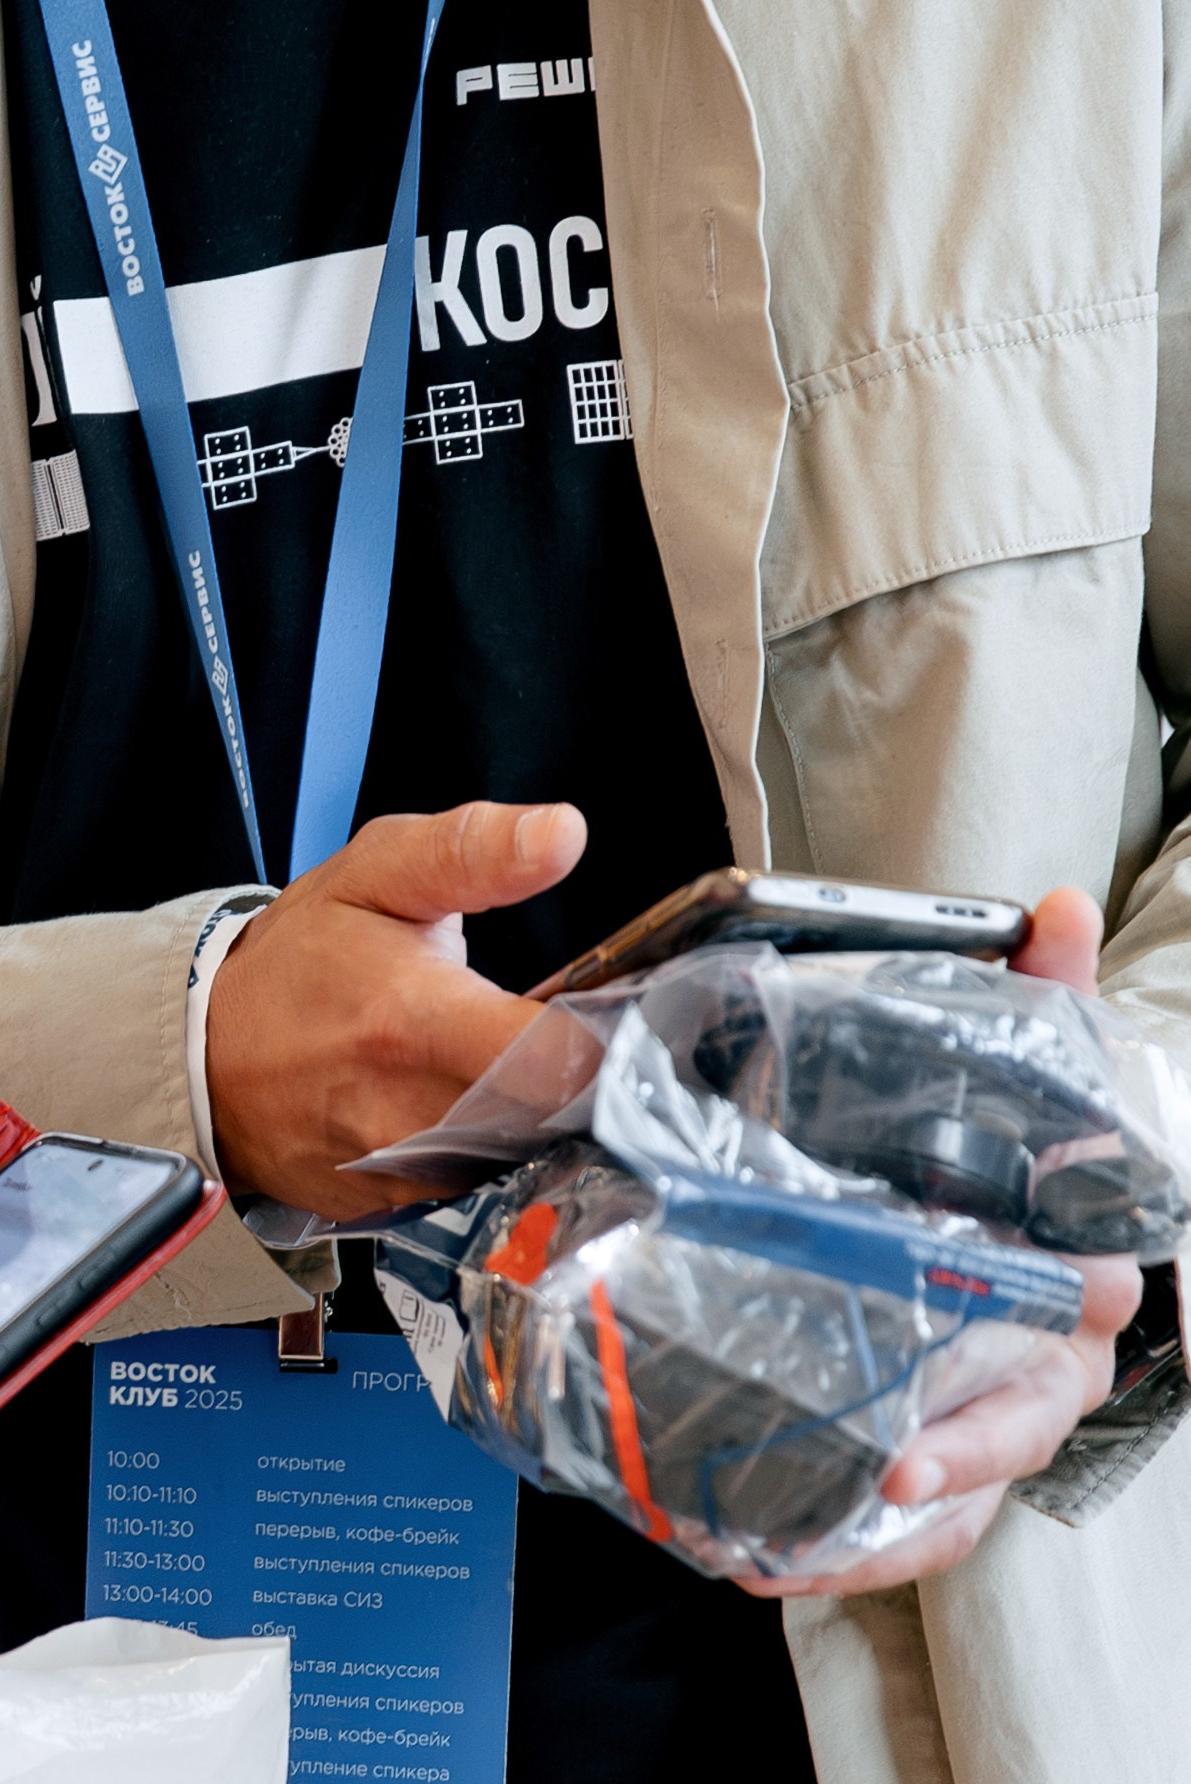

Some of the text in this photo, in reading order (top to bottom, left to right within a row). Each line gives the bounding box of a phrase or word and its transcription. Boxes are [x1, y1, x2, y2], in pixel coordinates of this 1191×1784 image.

[456, 56, 596, 106] РЕШ
[72, 39, 145, 297] ВОСТОК СЕРВИС
[415, 215, 609, 352] КОС
[188, 550, 219, 655] СЕРВИС
[110, 1361, 216, 1384] ВОСТОК
[109, 1386, 243, 1410] КЛУБ 2025
[108, 1450, 346, 1472] 10:00 открытие
[106, 1484, 474, 1513] 10:10-11:10 выступления спикеров
[105, 1517, 460, 1546] 11:10-11:30 перерыв, кофе-брейк
[104, 1550, 471, 1581] 11:30-13:00 выступления спикеров
[103, 1584, 383, 1609] 13:00-14:00 выставка СИЗ
[251, 1621, 297, 1641] обед
[290, 1659, 440, 1680] ытая дискуссия
[290, 1692, 465, 1716] упления спикеров
[289, 1726, 451, 1748] рыв, кофе-брейк
[289, 1760, 450, 1784] упление спикера
